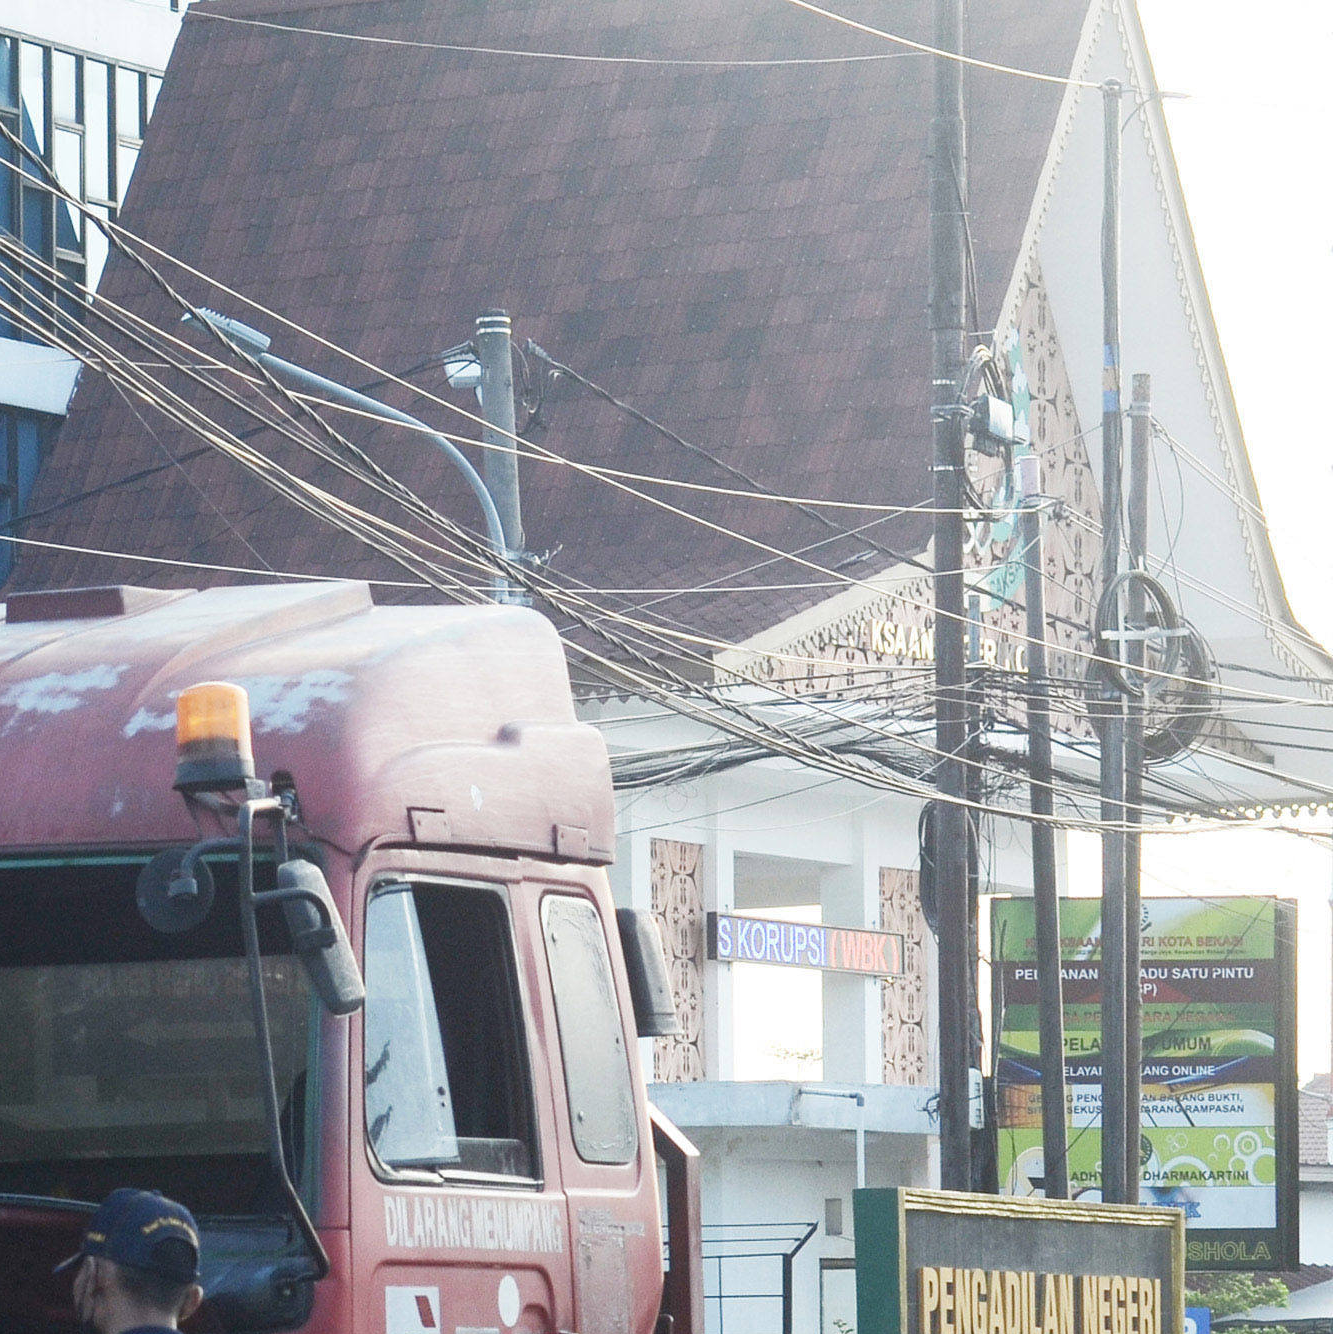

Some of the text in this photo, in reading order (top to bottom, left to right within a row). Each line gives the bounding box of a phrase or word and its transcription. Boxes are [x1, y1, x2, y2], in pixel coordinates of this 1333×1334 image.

[737, 920, 827, 967] KORUPSI
[1158, 936, 1192, 948] KOTA
[1171, 968, 1208, 979] SATU
[1212, 968, 1254, 979] PINTU
[1163, 1037, 1211, 1050] UMUM
[1172, 1065, 1215, 1076] ONLINE
[1208, 1093, 1244, 1103] BUKTI,
[1185, 1105, 1245, 1114] RAMPASAN
[1142, 1170, 1249, 1182] DHARMAKARTINI
[384, 1196, 471, 1248] DILARANG
[471, 1199, 563, 1253] MENUMPANG
[1187, 1241, 1271, 1261] SHOLA
